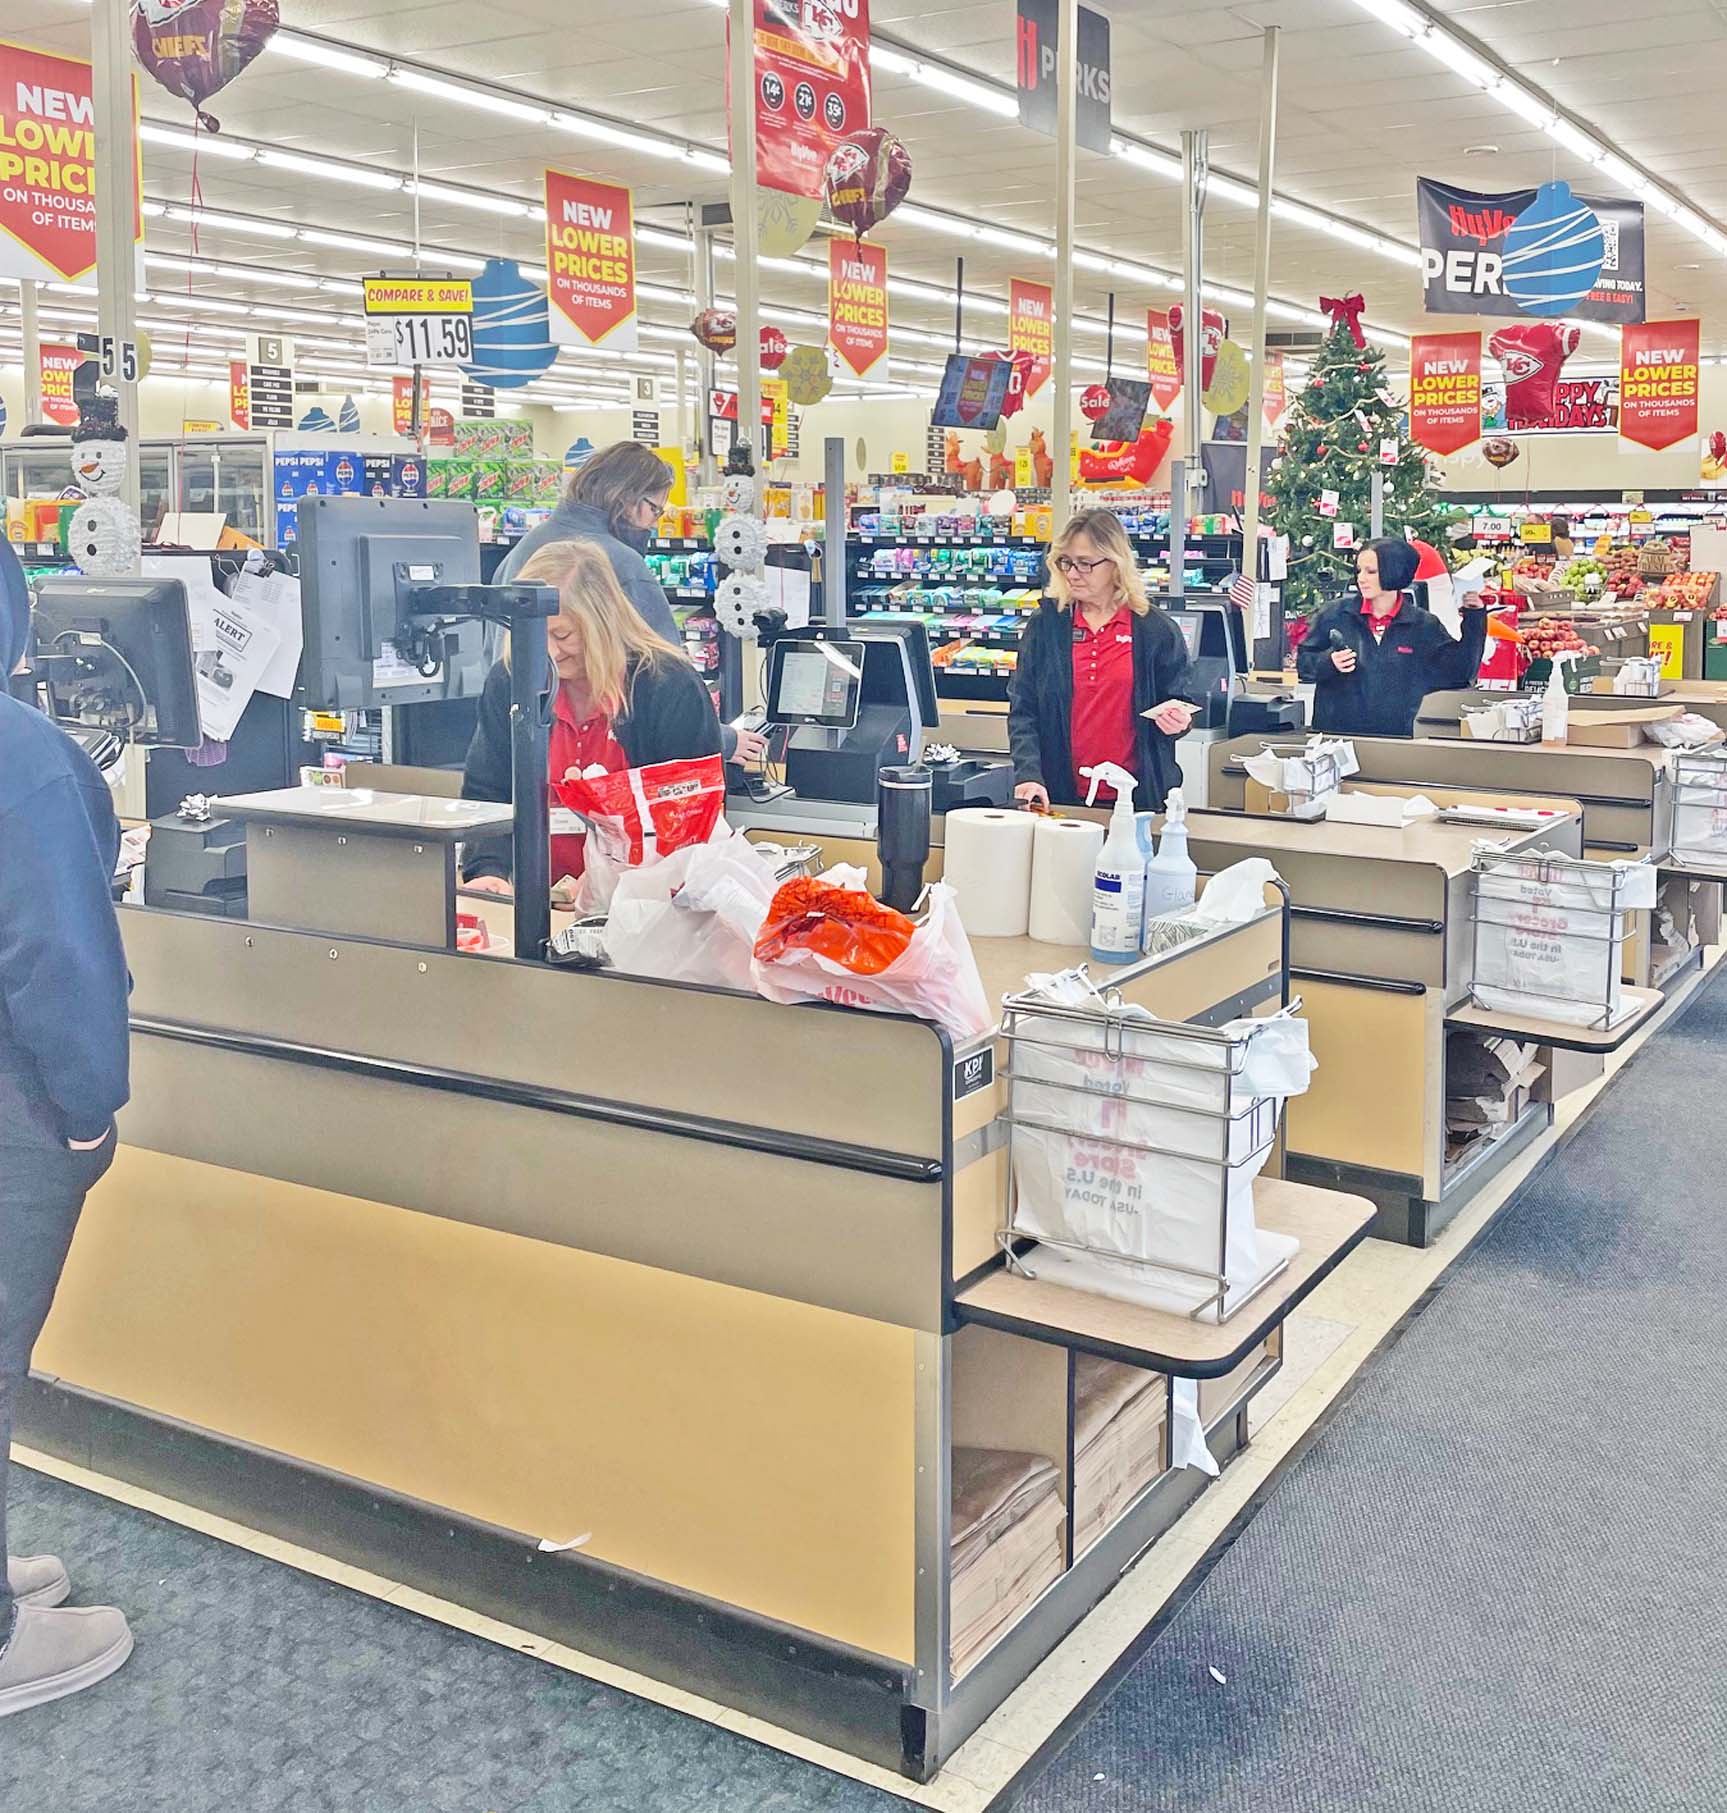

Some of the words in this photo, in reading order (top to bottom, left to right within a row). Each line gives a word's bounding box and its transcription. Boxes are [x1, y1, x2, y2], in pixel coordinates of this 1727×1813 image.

[16, 81, 95, 125] NEW
[0, 113, 95, 161] LOW
[0, 151, 95, 194] PRIC
[3, 187, 28, 204] ON
[32, 191, 95, 214] THOUSA
[32, 210, 53, 226] OF
[562, 199, 613, 230] NEW
[552, 223, 629, 259] LOWER
[554, 251, 629, 284] PRICES
[842, 258, 876, 283] NEW
[1421, 247, 1510, 295] PER
[367, 288, 424, 302] COMPARE
[426, 289, 434, 302] &
[438, 288, 469, 303] SAVE!
[556, 277, 571, 290] ON
[572, 279, 627, 299] THOUSANDS
[833, 279, 884, 307] LOWER
[571, 294, 584, 305] OF
[585, 297, 612, 310] ITEMS
[1018, 297, 1044, 317] NEW
[834, 301, 884, 327] PRICES
[1012, 314, 1050, 337] LOWER
[395, 318, 470, 360] $11.59
[1012, 335, 1050, 357] PRICES
[103, 337, 114, 376] 5
[267, 342, 279, 360] 5
[1635, 348, 1685, 366] NEW
[42, 355, 77, 369] NEW
[122, 342, 136, 381] 5
[1423, 358, 1469, 376] NEW
[1622, 364, 1697, 383] LOWER
[1412, 374, 1480, 392] LOWER
[1624, 381, 1696, 399] PRICES
[1081, 395, 1111, 408] Sale
[1413, 390, 1479, 407] PRICES
[1623, 401, 1637, 409] ON
[1638, 398, 1695, 409] THOUSANDS
[1413, 409, 1426, 417] ON
[1427, 406, 1478, 416] THOUSANDS
[1426, 417, 1438, 425] OF
[1439, 415, 1464, 425] ITEMS
[1638, 410, 1651, 418] OF
[1652, 408, 1680, 417] ITEMS
[275, 456, 299, 467] PEPSI
[299, 456, 324, 467] PEPSI
[365, 458, 391, 468] PEPSI
[277, 503, 298, 513] PEPS
[1482, 521, 1502, 531] 7.00
[214, 617, 246, 643] ALERT
